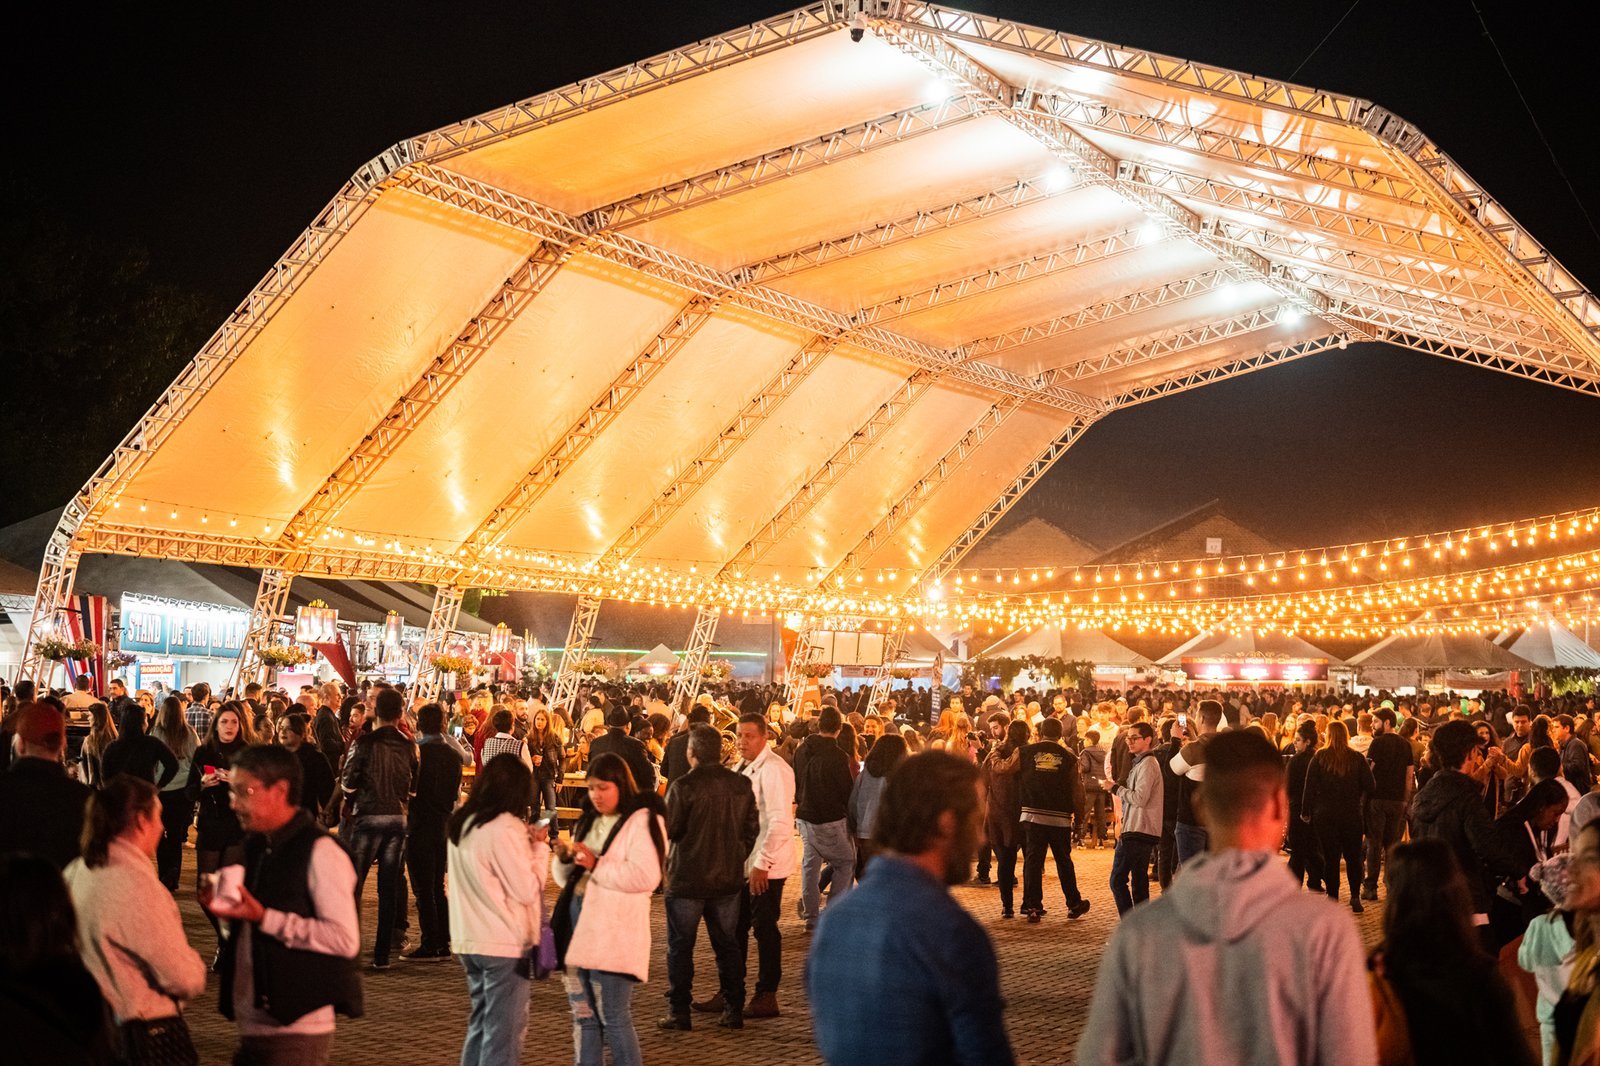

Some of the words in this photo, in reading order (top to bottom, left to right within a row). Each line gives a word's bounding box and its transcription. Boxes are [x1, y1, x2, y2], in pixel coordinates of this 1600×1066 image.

[128, 611, 161, 644] STAND
[171, 617, 183, 646] DE
[186, 618, 207, 648] TIRO
